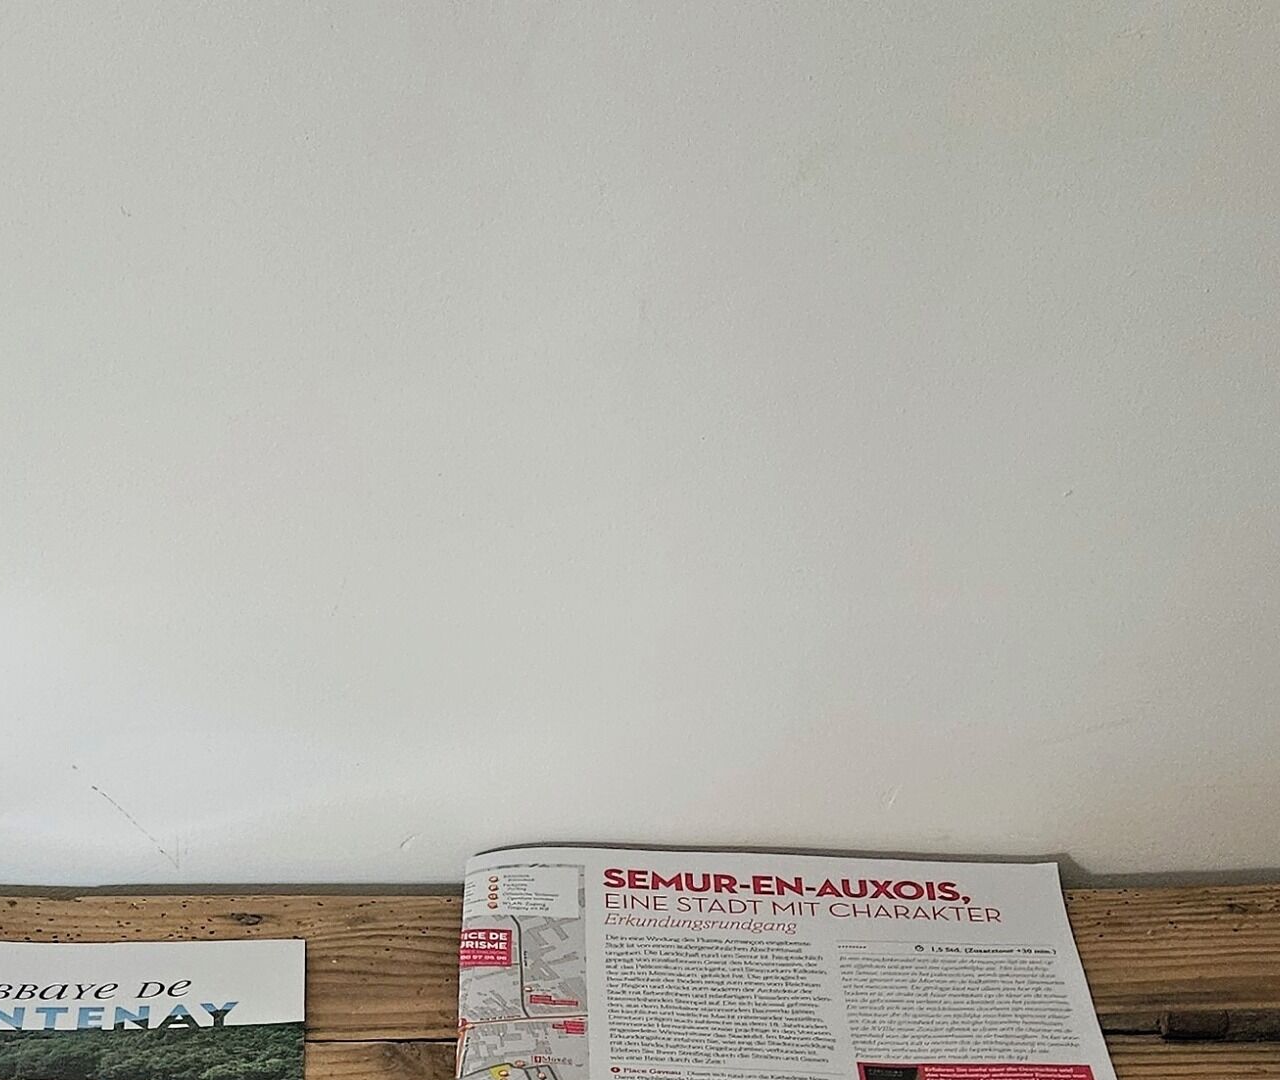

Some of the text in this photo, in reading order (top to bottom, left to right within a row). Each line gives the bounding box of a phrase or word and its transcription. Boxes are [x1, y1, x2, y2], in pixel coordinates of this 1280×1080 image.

[603, 867, 972, 905] SEMUR-EN-AUXOIS,
[604, 912, 797, 935] Erkundungsrundgang
[605, 892, 1002, 924] EINE STADT MIT CHARAKTER
